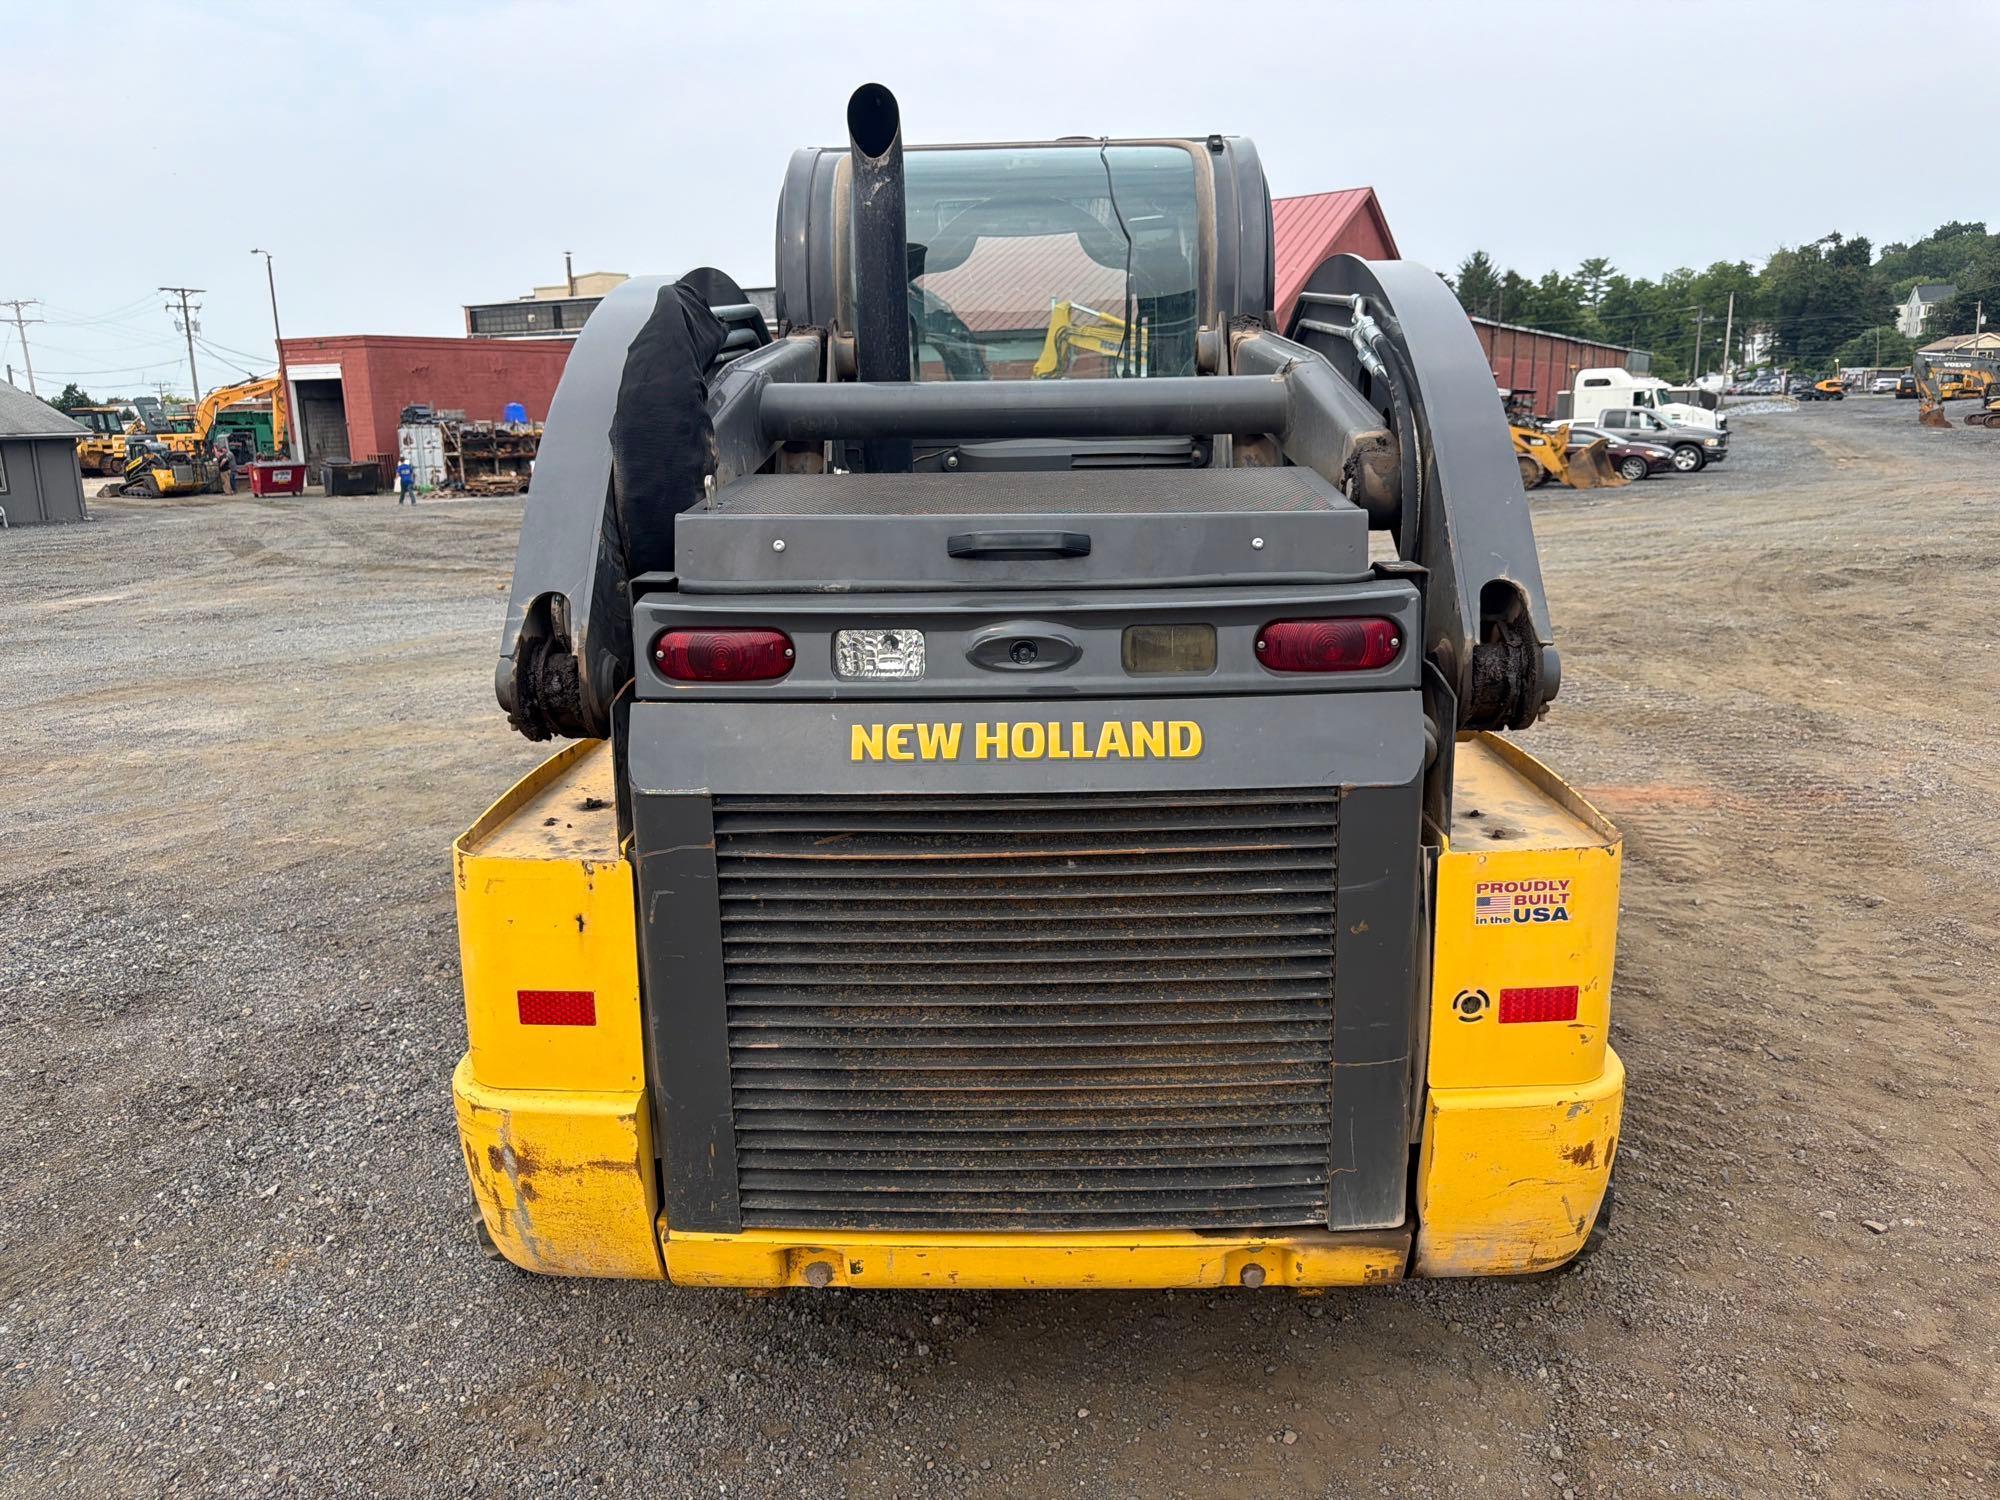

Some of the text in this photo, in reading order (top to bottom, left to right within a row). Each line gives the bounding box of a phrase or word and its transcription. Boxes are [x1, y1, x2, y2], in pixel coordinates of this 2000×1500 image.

[851, 721, 1203, 761] NEW HOLLAND
[1476, 880, 1570, 894] PROUDLY
[1514, 893, 1570, 906] BUILT
[1475, 906, 1569, 925] in the USA
